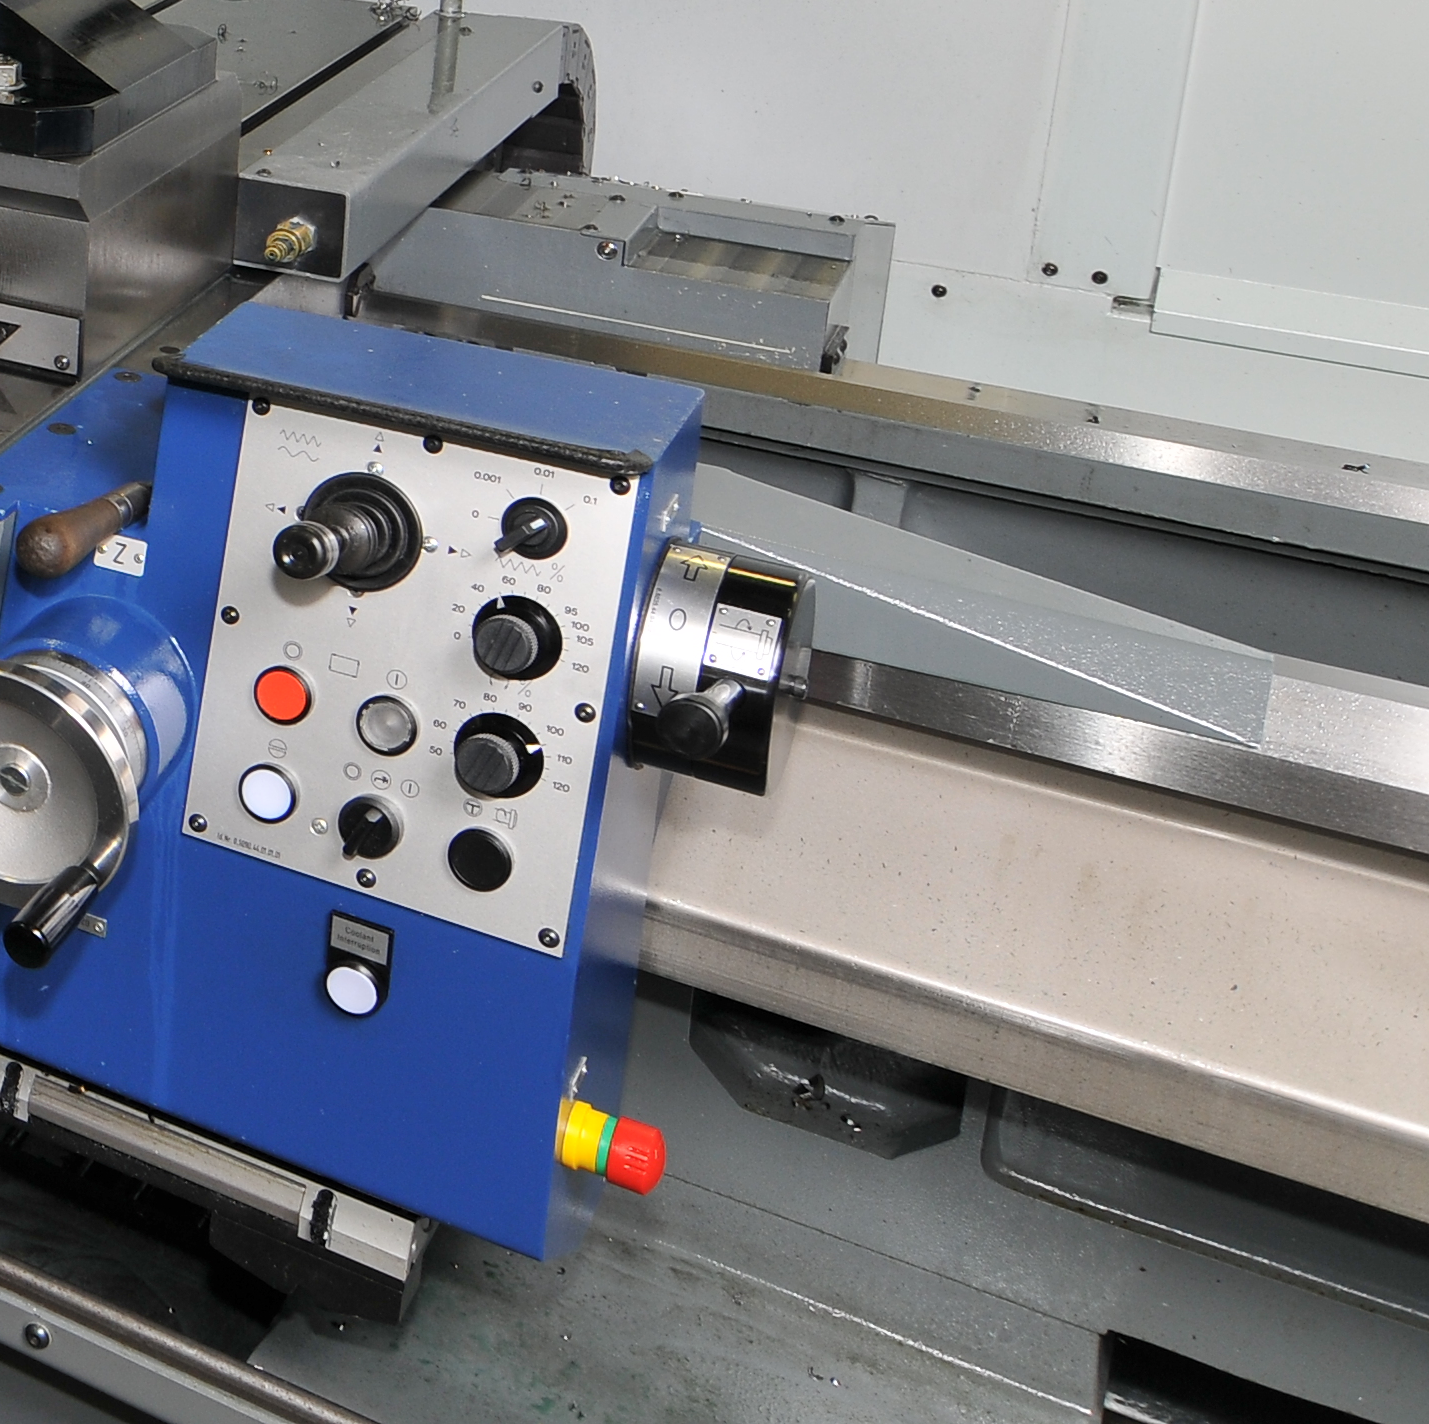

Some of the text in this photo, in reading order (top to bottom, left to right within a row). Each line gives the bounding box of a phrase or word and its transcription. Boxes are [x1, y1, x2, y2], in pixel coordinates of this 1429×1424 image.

[473, 471, 502, 484] 0.001
[534, 467, 555, 479] 0.01
[583, 495, 598, 505] 0.1
[471, 509, 480, 519] 0
[112, 541, 128, 565] Z
[501, 575, 517, 586] 60
[471, 583, 485, 593] 40
[536, 584, 552, 595] 80
[451, 603, 466, 614] 20
[564, 605, 578, 617] 95
[571, 620, 590, 632] 100
[453, 631, 461, 640] 0
[576, 634, 594, 647] 105
[571, 662, 590, 674] 120
[483, 692, 498, 703] 80
[453, 698, 467, 709] 70
[518, 701, 532, 713] 90
[433, 719, 448, 729] 60
[546, 725, 565, 737] 100
[429, 745, 443, 756] 50
[557, 754, 573, 765] 110
[552, 781, 571, 793] 120
[344, 926, 375, 943] Coolant
[337, 933, 381, 955] Interruption
